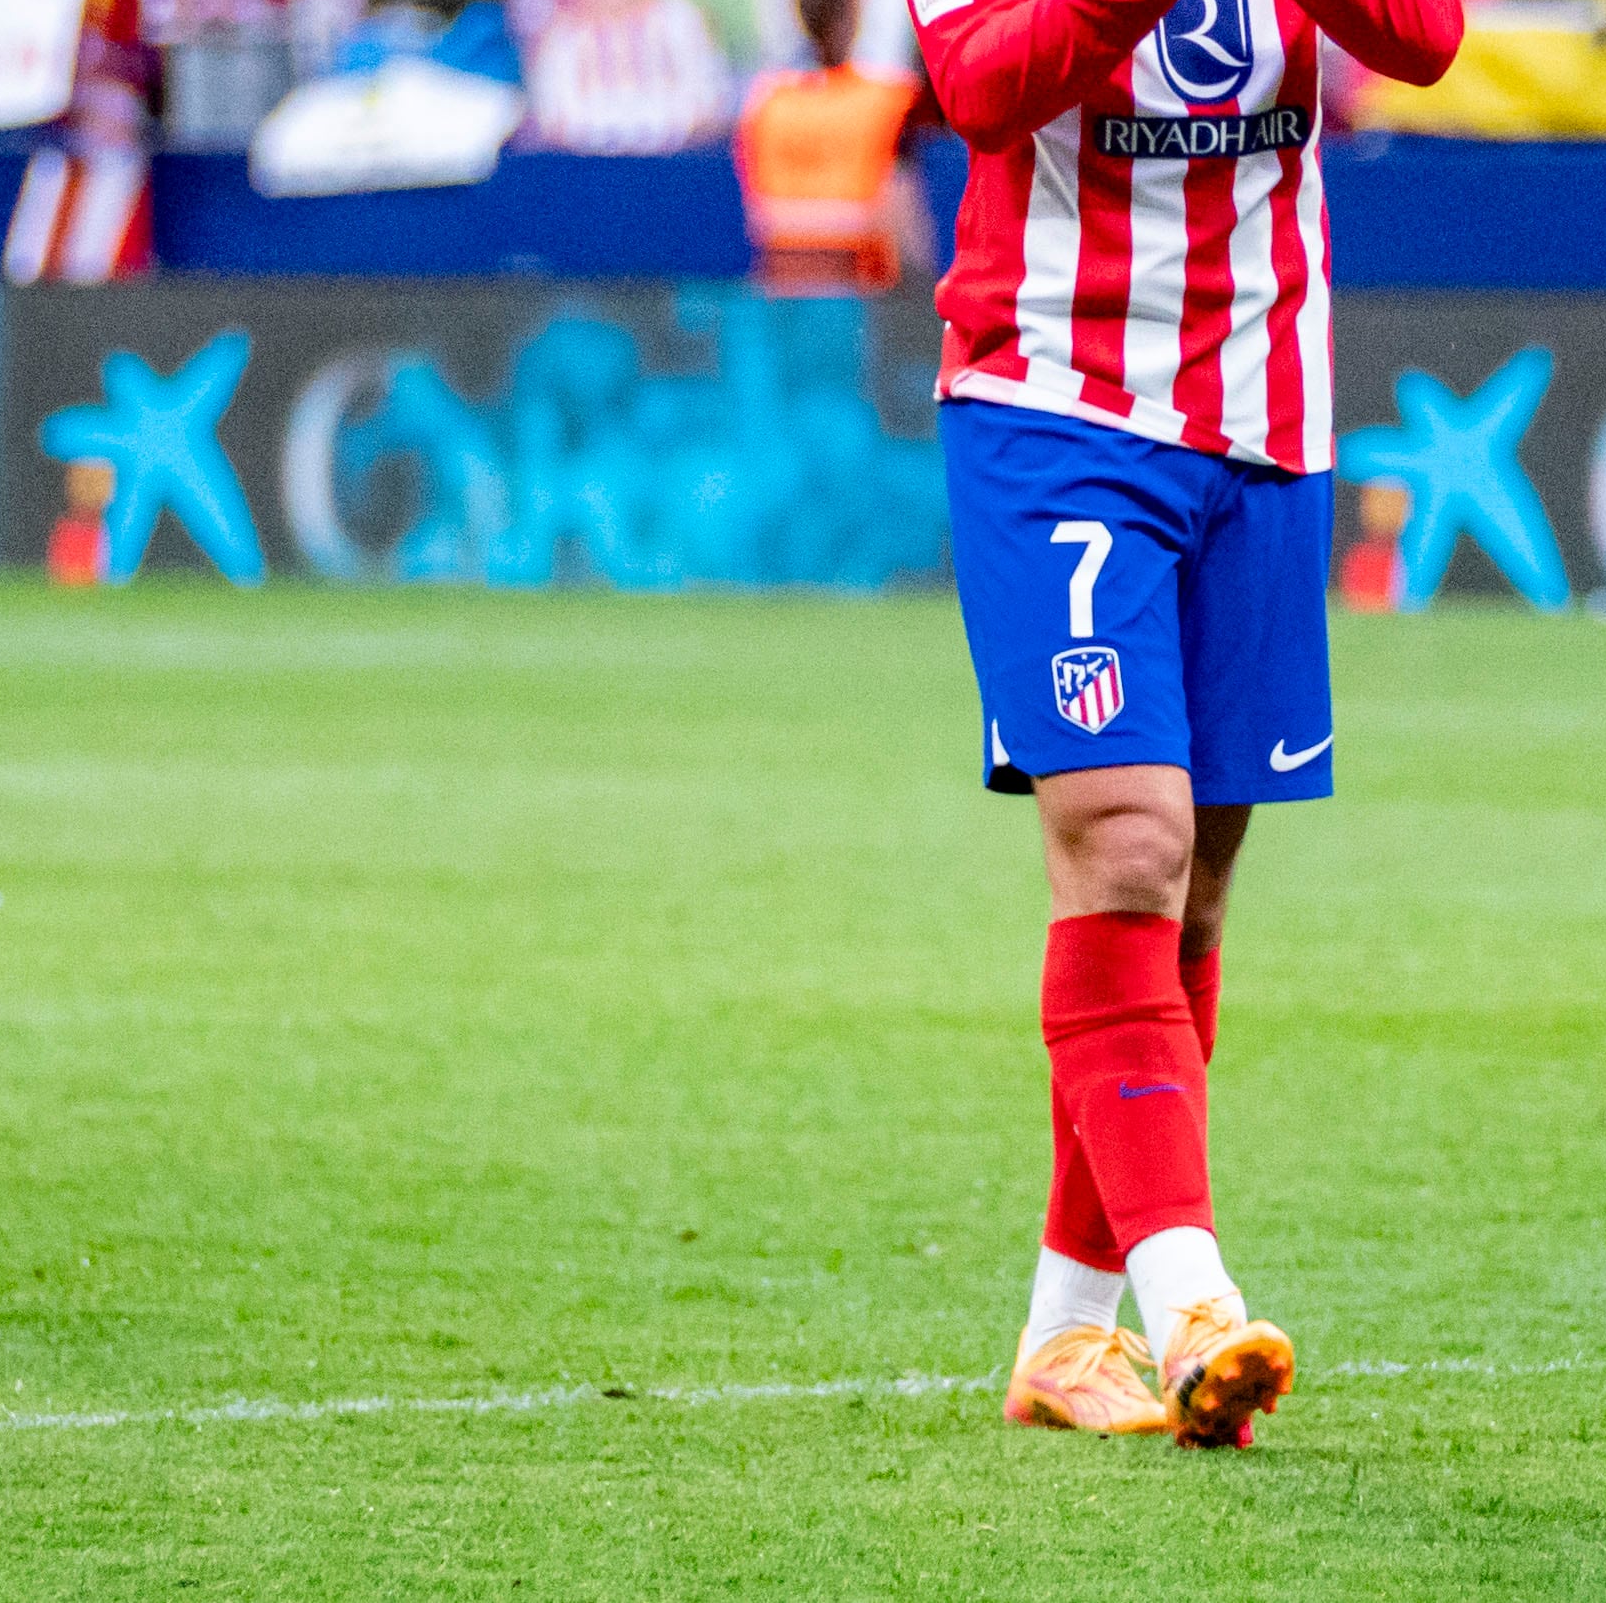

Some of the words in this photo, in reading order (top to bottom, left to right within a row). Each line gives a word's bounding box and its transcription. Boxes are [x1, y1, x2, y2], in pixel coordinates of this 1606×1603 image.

[1104, 119, 1247, 155] RIYADH
[1251, 110, 1303, 149] AIR
[1049, 520, 1114, 639] 7
